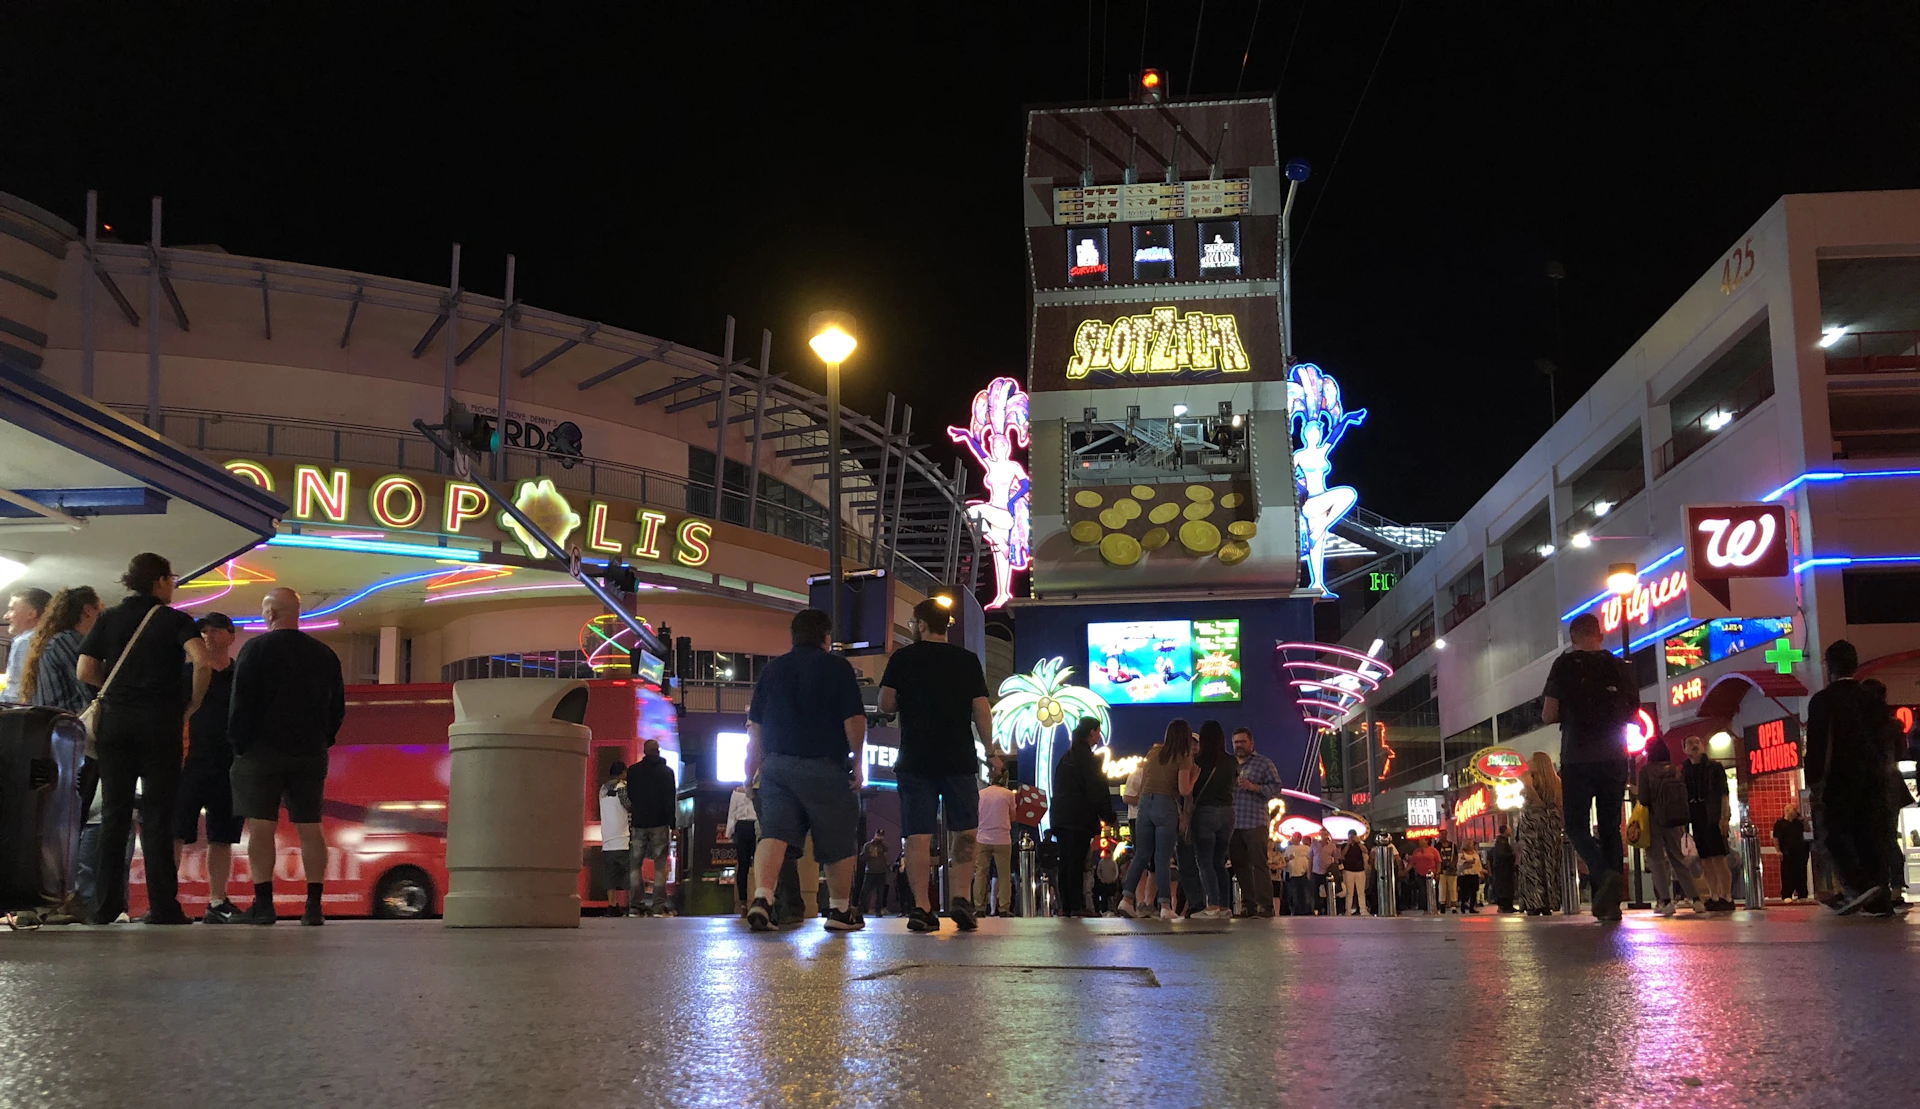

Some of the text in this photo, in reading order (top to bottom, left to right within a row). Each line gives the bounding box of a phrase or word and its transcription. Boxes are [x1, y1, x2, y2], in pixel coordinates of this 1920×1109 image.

[1071, 264, 1107, 276] SURVIVAL
[1720, 234, 1754, 295] 425
[1066, 306, 1250, 379] SLOTZILLA
[471, 405, 498, 415] FLOOR
[504, 410, 526, 420] BOVE
[530, 415, 558, 426] DENNY'S
[1699, 513, 1775, 568] W
[1672, 677, 1702, 705] 24-HR
[1758, 720, 1784, 748] OPEN
[1750, 741, 1798, 774] 24 HOURS
[1410, 798, 1429, 808] FEAR
[1411, 814, 1434, 825] DEAD
[1406, 828, 1440, 840] SURVIVAL
